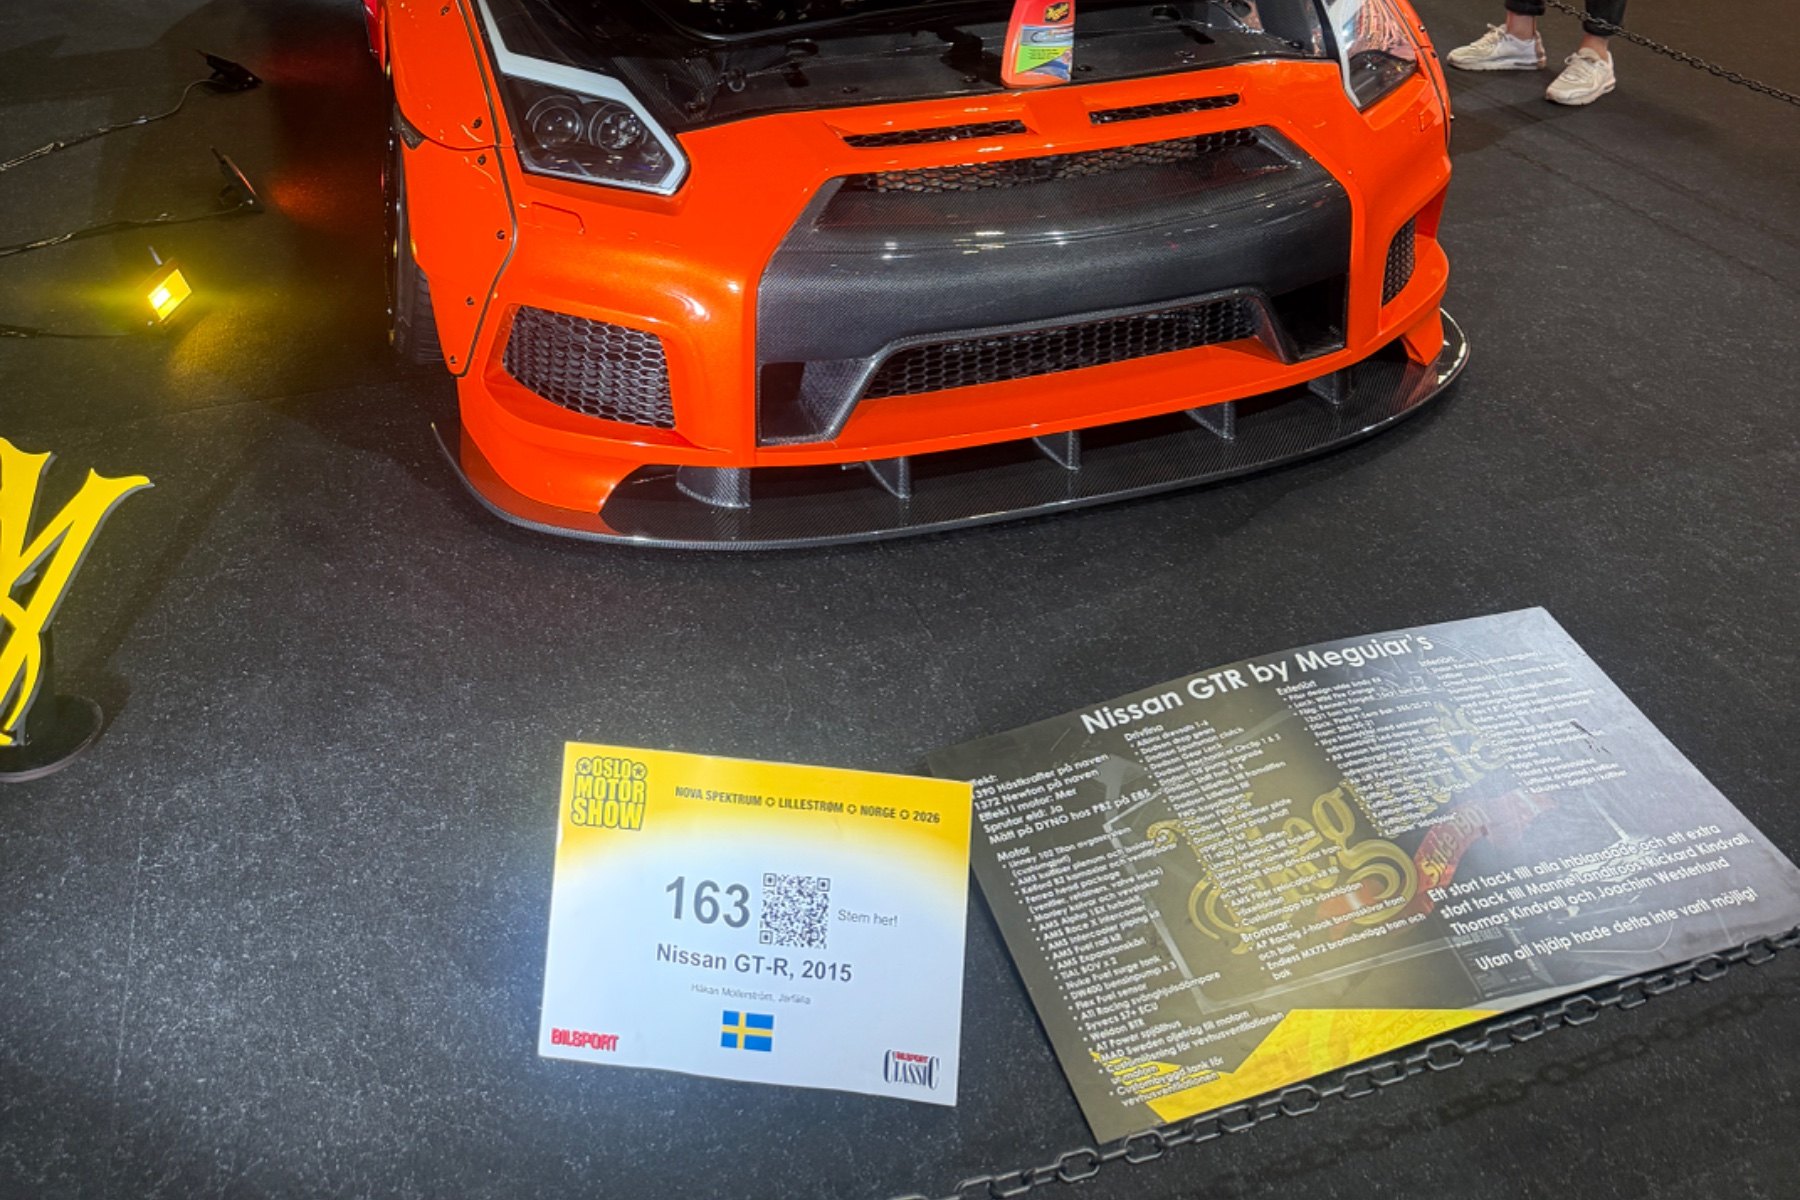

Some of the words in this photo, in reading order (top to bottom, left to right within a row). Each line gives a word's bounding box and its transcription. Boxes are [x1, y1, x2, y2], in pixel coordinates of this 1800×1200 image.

[1080, 689, 1183, 735] Nissan
[1186, 667, 1249, 700] GTR
[1248, 659, 1290, 684] by
[1294, 632, 1434, 674] Meguiar's
[592, 756, 632, 779] OSLO
[575, 773, 646, 804] MOTOR
[675, 786, 703, 800] NOVA
[705, 790, 762, 806] SPEKTRUM
[778, 797, 844, 813] LILLESTRØM
[860, 805, 896, 818] NORGE
[913, 810, 940, 824] 2026
[1002, 785, 1044, 802] Newton
[1046, 779, 1062, 790] på
[571, 797, 645, 831] SHOW
[1016, 825, 1033, 837] på
[1034, 814, 1068, 830] DYNO
[1070, 808, 1090, 820] hos
[1113, 796, 1130, 808] på
[1048, 804, 1063, 814] Ja
[996, 845, 1031, 861] Motor
[1426, 886, 1448, 903] Ett
[1450, 878, 1480, 898] stort
[1481, 869, 1515, 891] tack
[1515, 866, 1532, 881] till
[1534, 859, 1561, 876] alla
[1561, 841, 1636, 870] inblandade
[1638, 835, 1668, 852] och
[1667, 831, 1686, 846] ett
[1685, 823, 1722, 843] extra
[1439, 901, 1471, 920] stort
[1472, 892, 1507, 912] tack
[1508, 887, 1524, 903] till
[1525, 875, 1576, 898] Manne
[1697, 831, 1755, 855] Kindvall,
[665, 876, 750, 928] 163
[1450, 913, 1510, 937] Thomas
[1509, 898, 1567, 924] Kindvall
[1567, 891, 1597, 909] och
[1597, 876, 1655, 901] Joachim
[1657, 856, 1730, 885] Westerlund
[838, 909, 871, 923] Stem
[1475, 952, 1512, 972] Utan
[1513, 944, 1534, 961] all
[1533, 934, 1572, 959] hjälp
[1573, 925, 1612, 946] hade
[1613, 915, 1651, 935] detta
[1651, 908, 1678, 926] inte
[1679, 900, 1708, 919] varit
[656, 943, 727, 970] Nissan
[734, 953, 794, 981] GT-R,
[801, 959, 852, 982] 2015
[551, 1027, 619, 1052] BILSPORT
